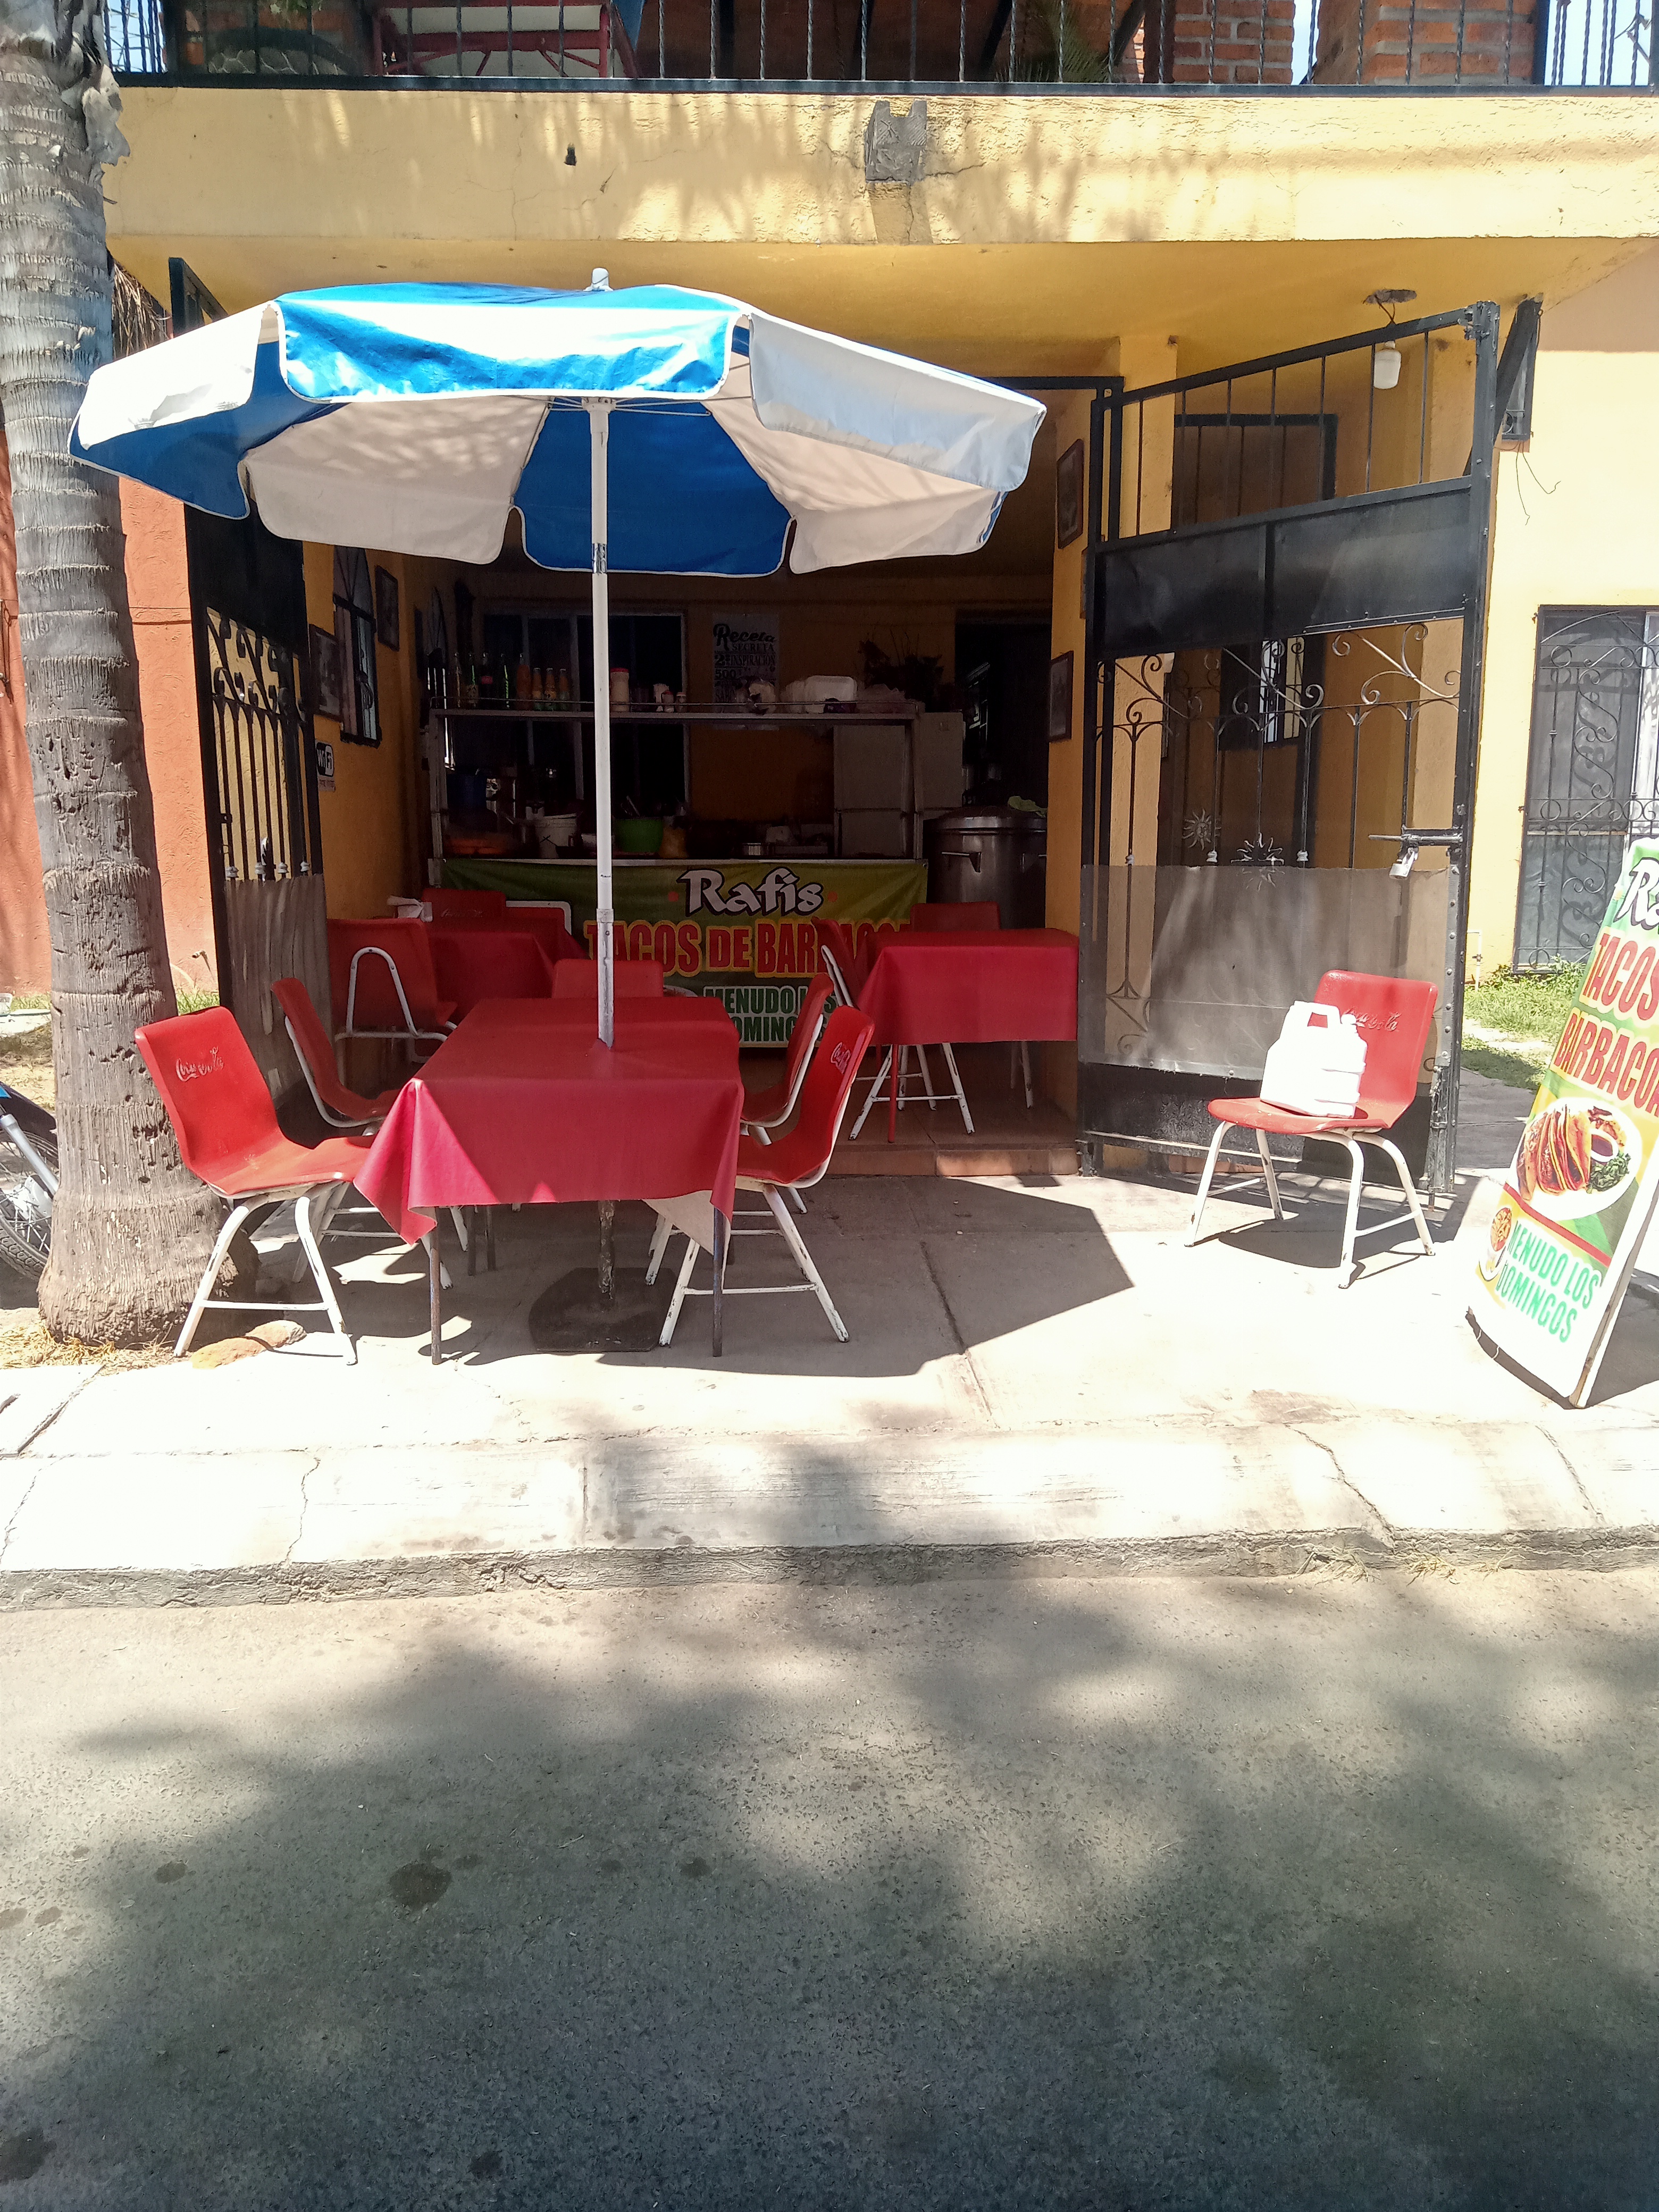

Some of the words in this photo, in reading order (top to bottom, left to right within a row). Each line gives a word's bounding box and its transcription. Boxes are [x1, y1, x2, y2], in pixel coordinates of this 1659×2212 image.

[677, 867, 824, 917] Rafis
[708, 929, 750, 968] DE
[757, 924, 910, 973] BARA
[1507, 1219, 1569, 1287] MENUDO
[1563, 1261, 1599, 1309] LOS
[1495, 1259, 1578, 1343] DOMINGOS
